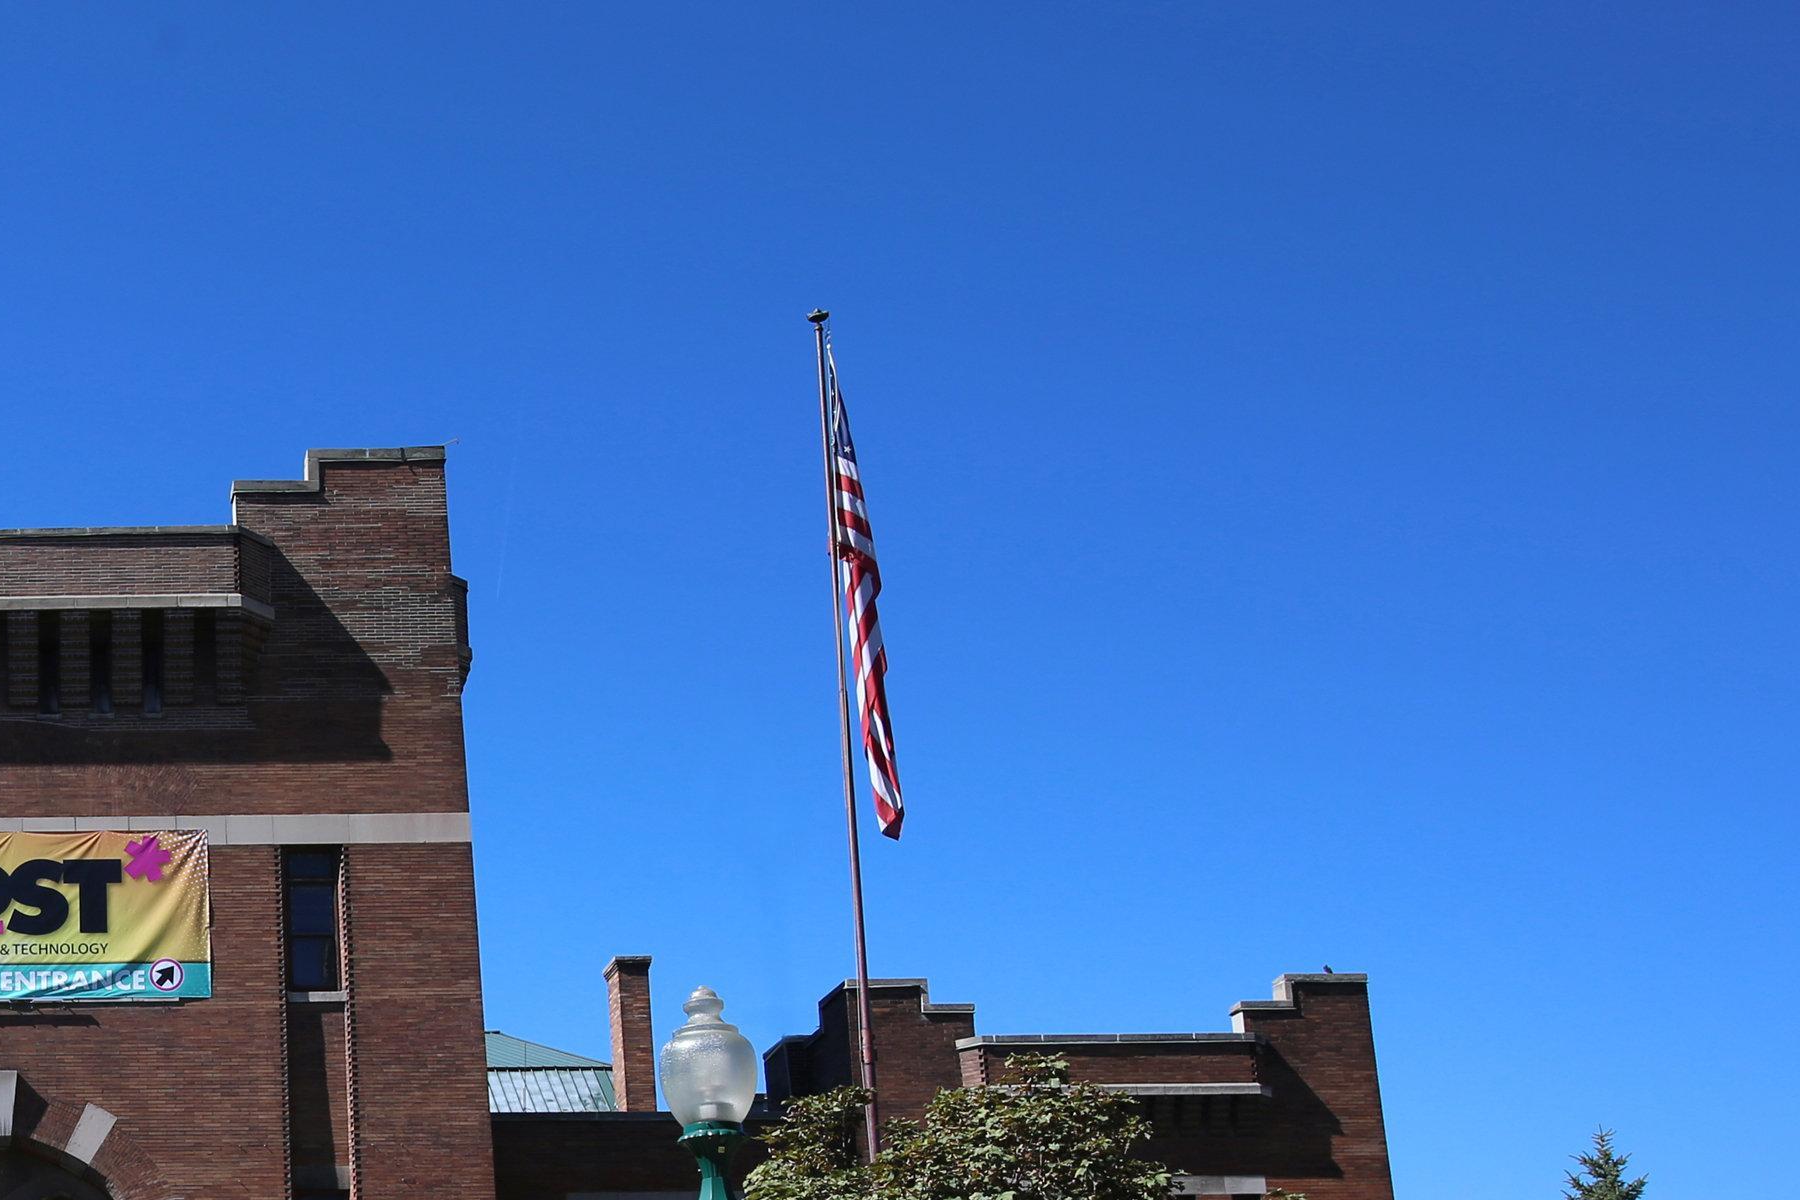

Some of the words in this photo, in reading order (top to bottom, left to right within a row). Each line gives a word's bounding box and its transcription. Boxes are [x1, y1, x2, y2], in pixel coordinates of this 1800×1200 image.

[0, 944, 10, 956] &
[14, 943, 109, 955] TECHNOLOGY
[0, 969, 146, 991] ENTRANCE
